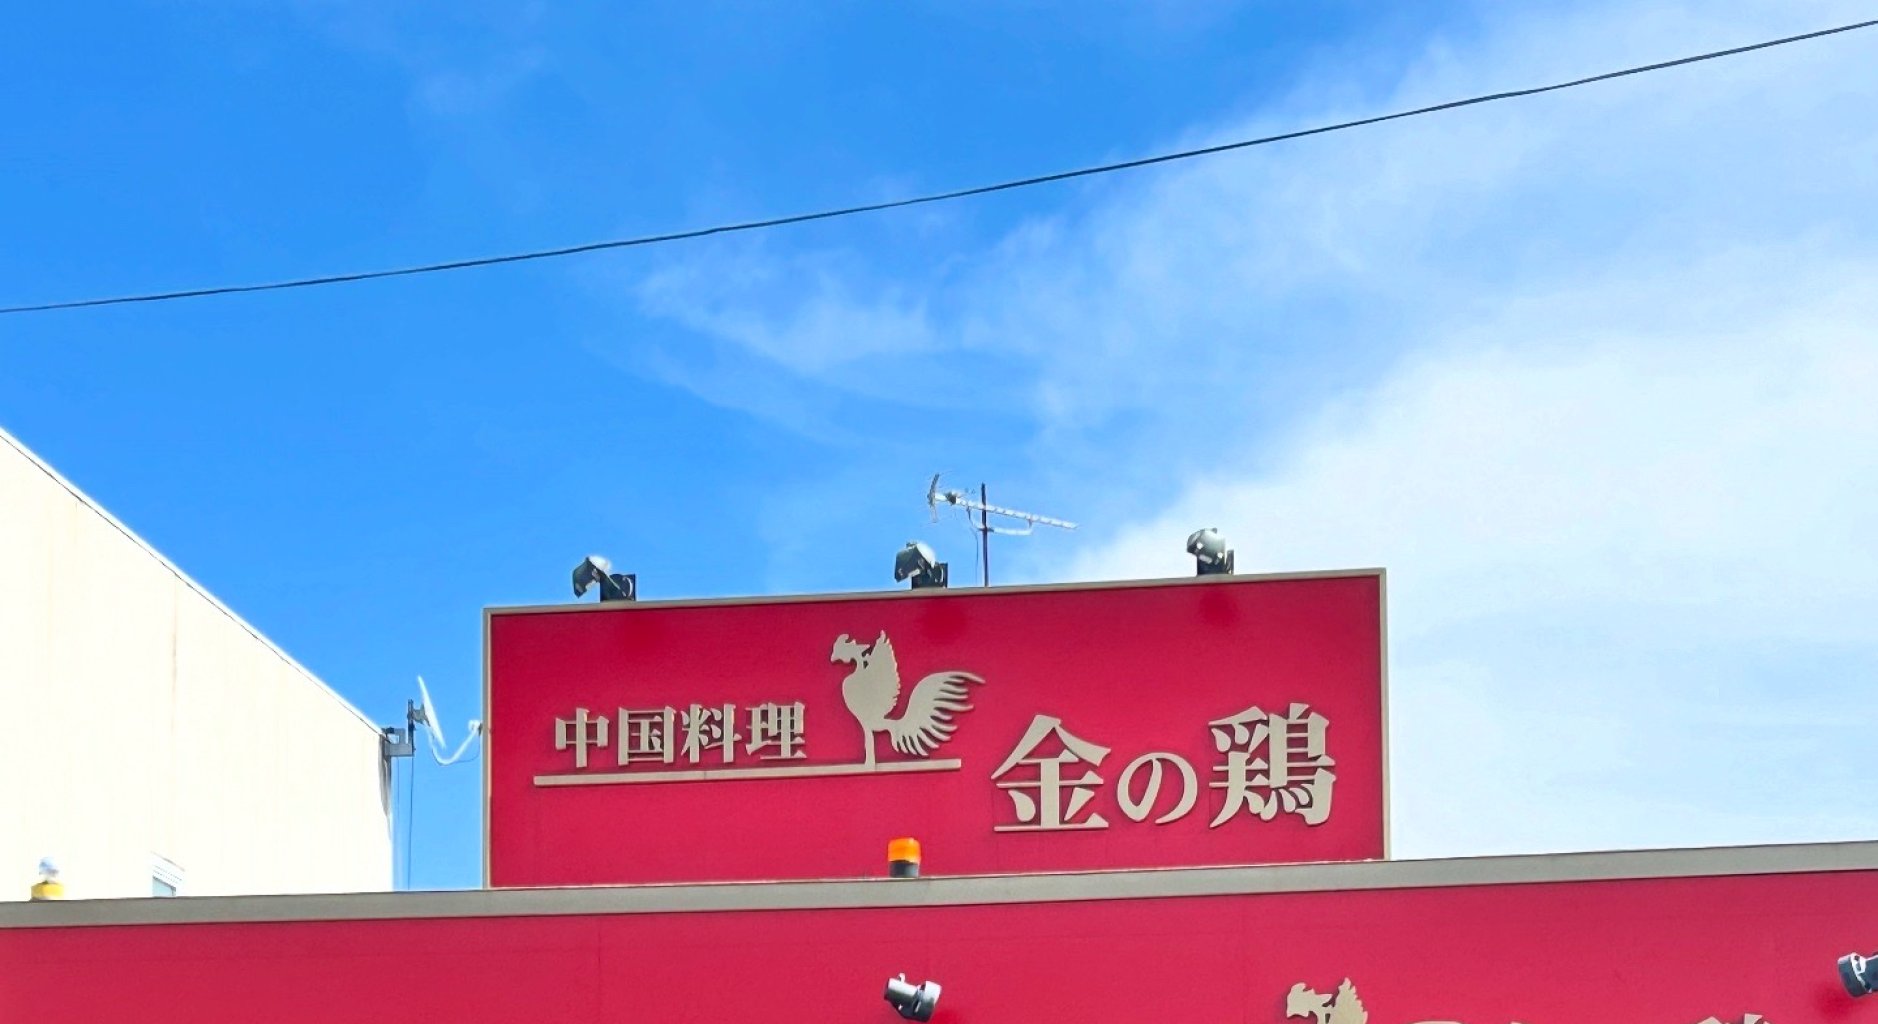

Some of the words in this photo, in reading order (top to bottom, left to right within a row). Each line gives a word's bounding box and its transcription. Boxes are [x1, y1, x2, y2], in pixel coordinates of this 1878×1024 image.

[555, 701, 807, 768] 中国料理
[991, 703, 1336, 831] 金の鶏
